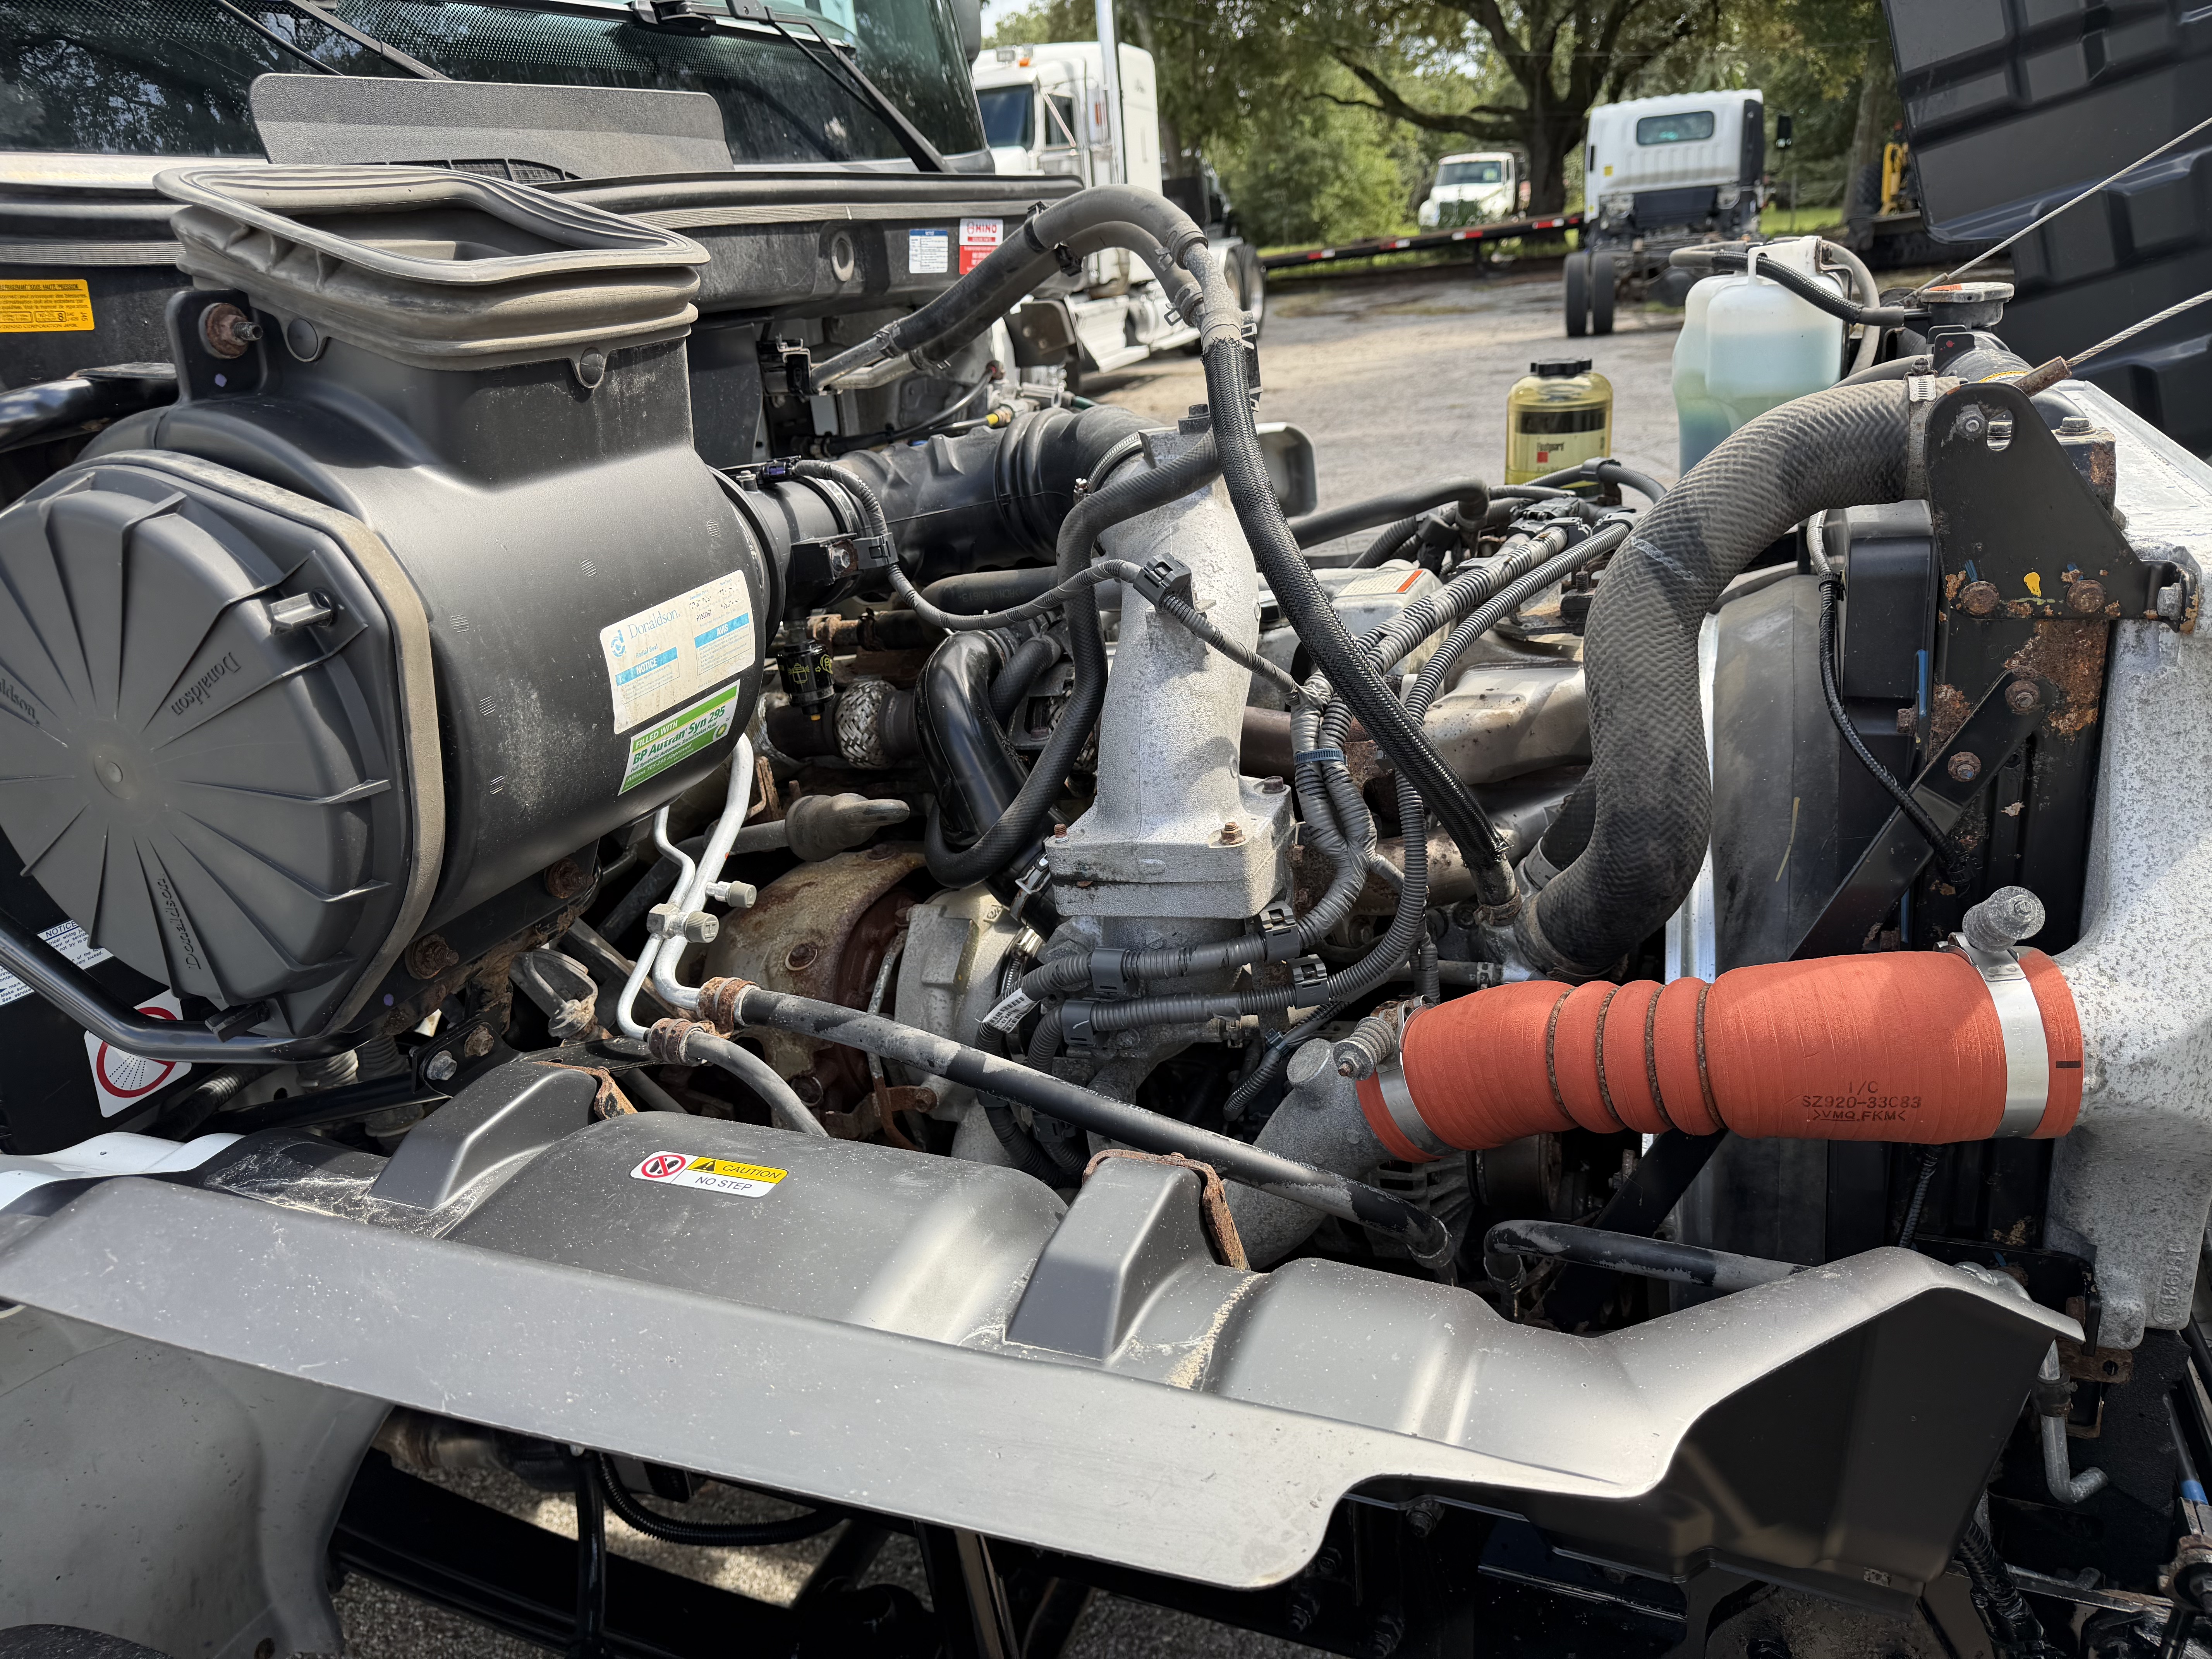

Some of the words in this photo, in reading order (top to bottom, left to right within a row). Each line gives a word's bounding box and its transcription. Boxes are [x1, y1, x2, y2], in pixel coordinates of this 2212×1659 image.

[976, 224, 997, 233] HINO
[58, 313, 64, 321] 8
[627, 610, 678, 639] Donaldson
[716, 625, 729, 636] AVIS
[636, 657, 658, 675] NOTICE
[170, 652, 242, 716] Donaldson
[0, 678, 36, 719] ldson
[633, 748, 648, 765] BP
[688, 718, 707, 735] Syn
[708, 705, 726, 723] 295
[635, 731, 659, 749] FILLED
[660, 720, 678, 736] WITH
[639, 755, 659, 769] Synthetic
[660, 743, 682, 758] Automatic
[707, 721, 717, 730] Fluid
[45, 921, 77, 938] NOTICE
[0, 989, 14, 998] Make
[14, 988, 31, 998] service
[1803, 1095, 1922, 1109] SZ920-33C83
[723, 1165, 782, 1178] CAUTION
[695, 1176, 716, 1185] NO
[718, 1180, 752, 1190] STEP
